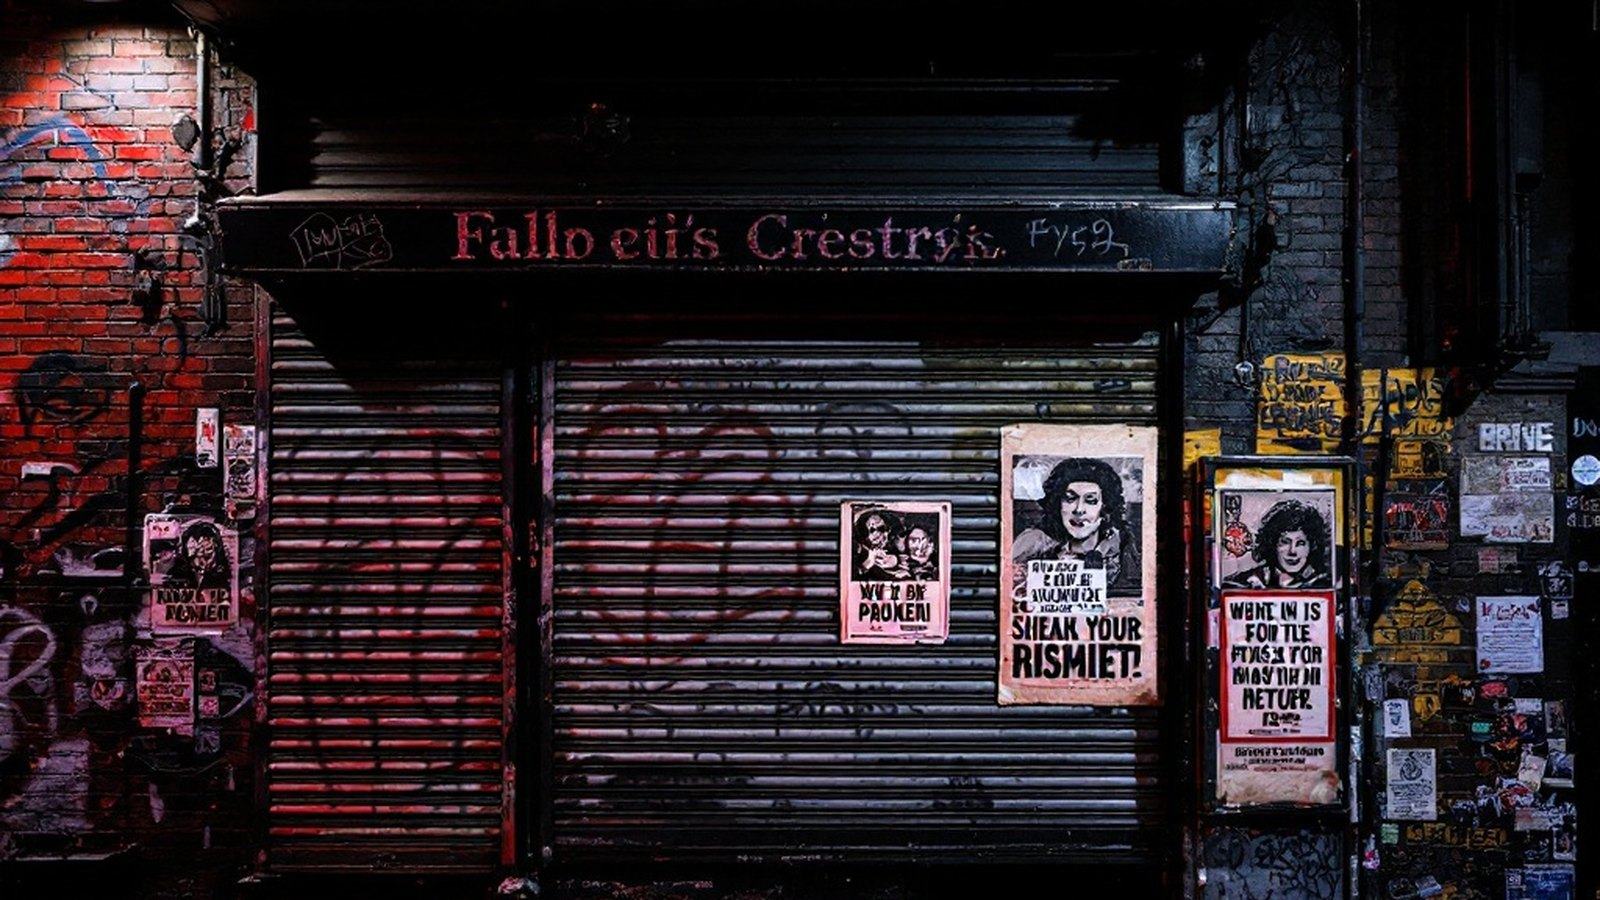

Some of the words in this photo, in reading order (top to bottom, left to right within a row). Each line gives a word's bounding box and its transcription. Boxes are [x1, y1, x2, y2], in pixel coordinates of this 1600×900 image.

[1304, 602, 1321, 621] IS
[1086, 615, 1142, 641] YOUR
[1012, 643, 1142, 678] RISMIET!
